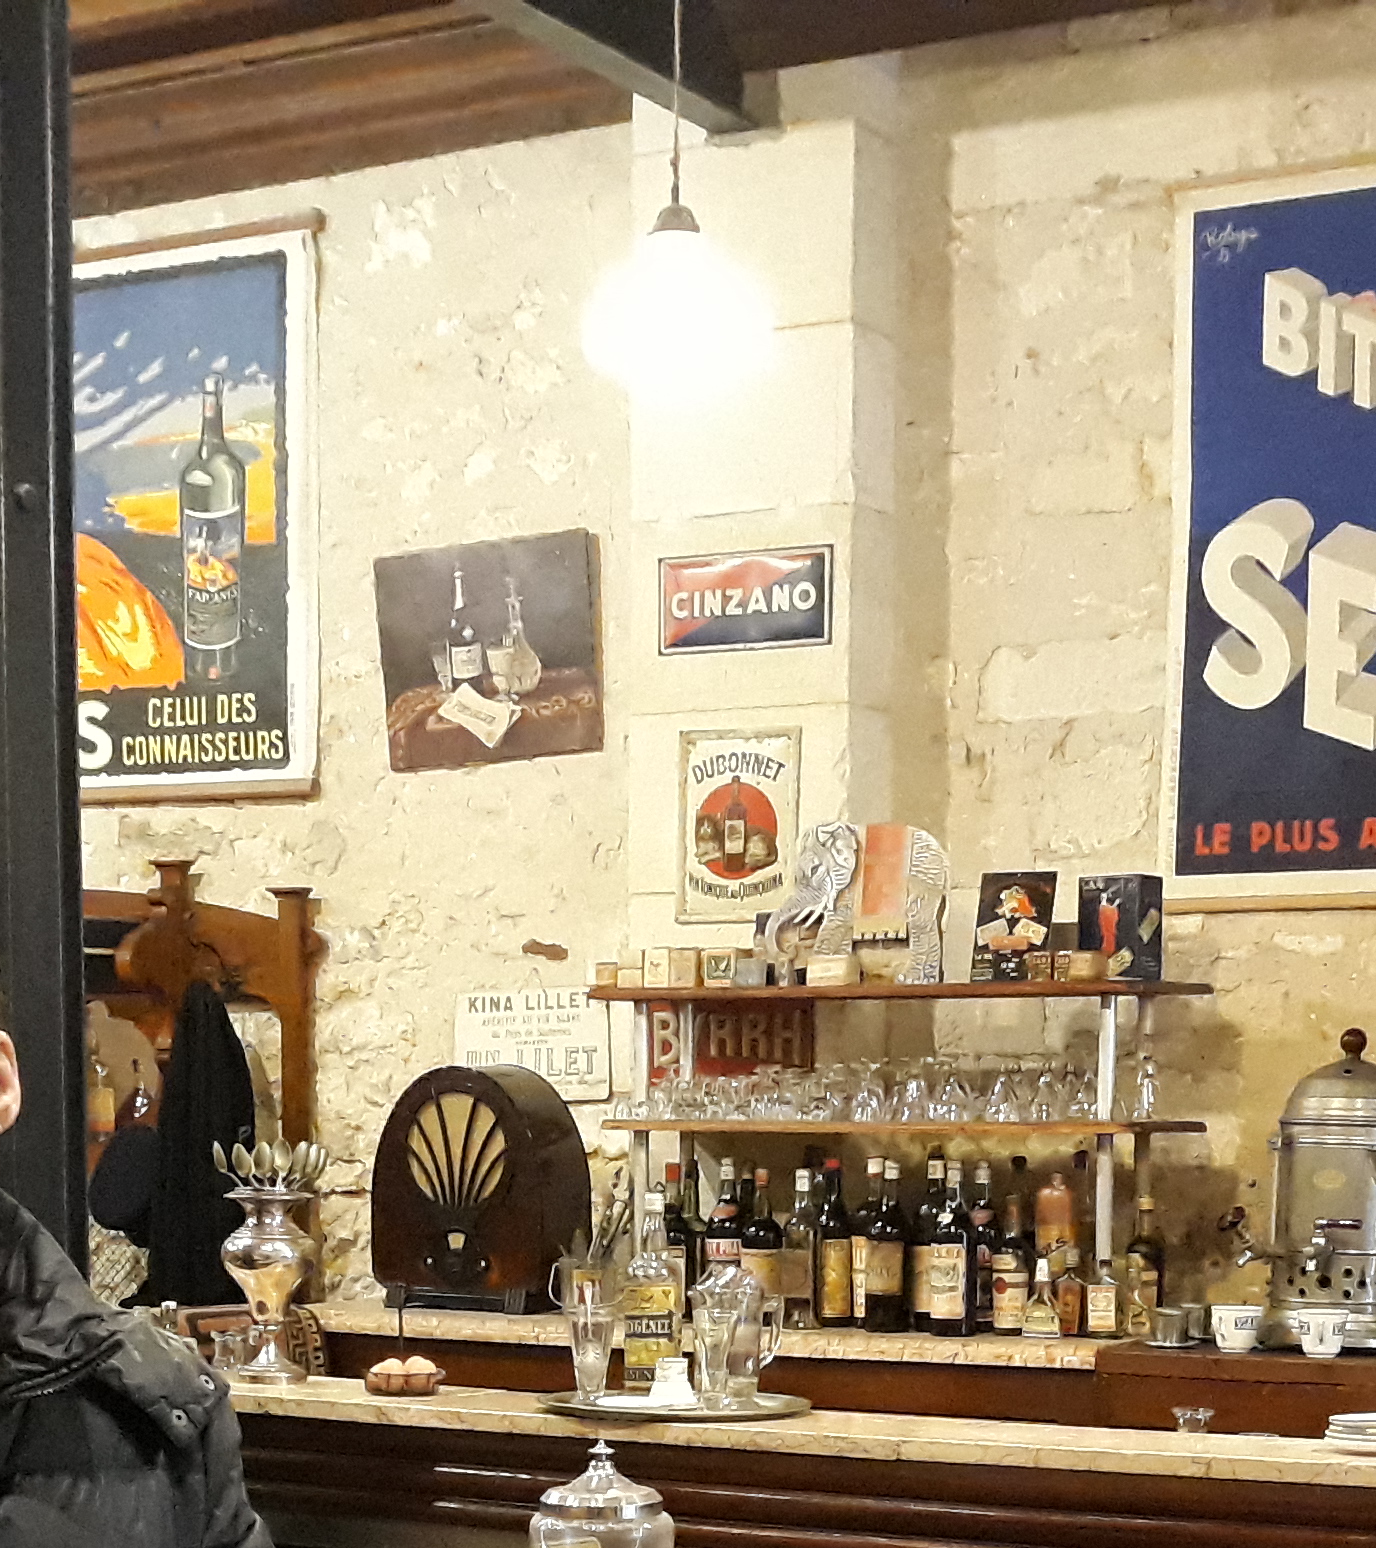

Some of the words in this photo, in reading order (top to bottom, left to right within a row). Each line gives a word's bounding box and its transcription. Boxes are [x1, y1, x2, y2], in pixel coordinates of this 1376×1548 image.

[669, 581, 817, 620] CINZANO
[147, 695, 207, 728] CELUI
[217, 692, 257, 724] DES
[122, 729, 284, 766] CONNAISSEURS
[691, 751, 786, 785] DUBONNET
[1194, 822, 1231, 857] LE
[1250, 818, 1341, 853] PLUS
[468, 995, 513, 1015] KINA
[525, 991, 592, 1012] LILLET
